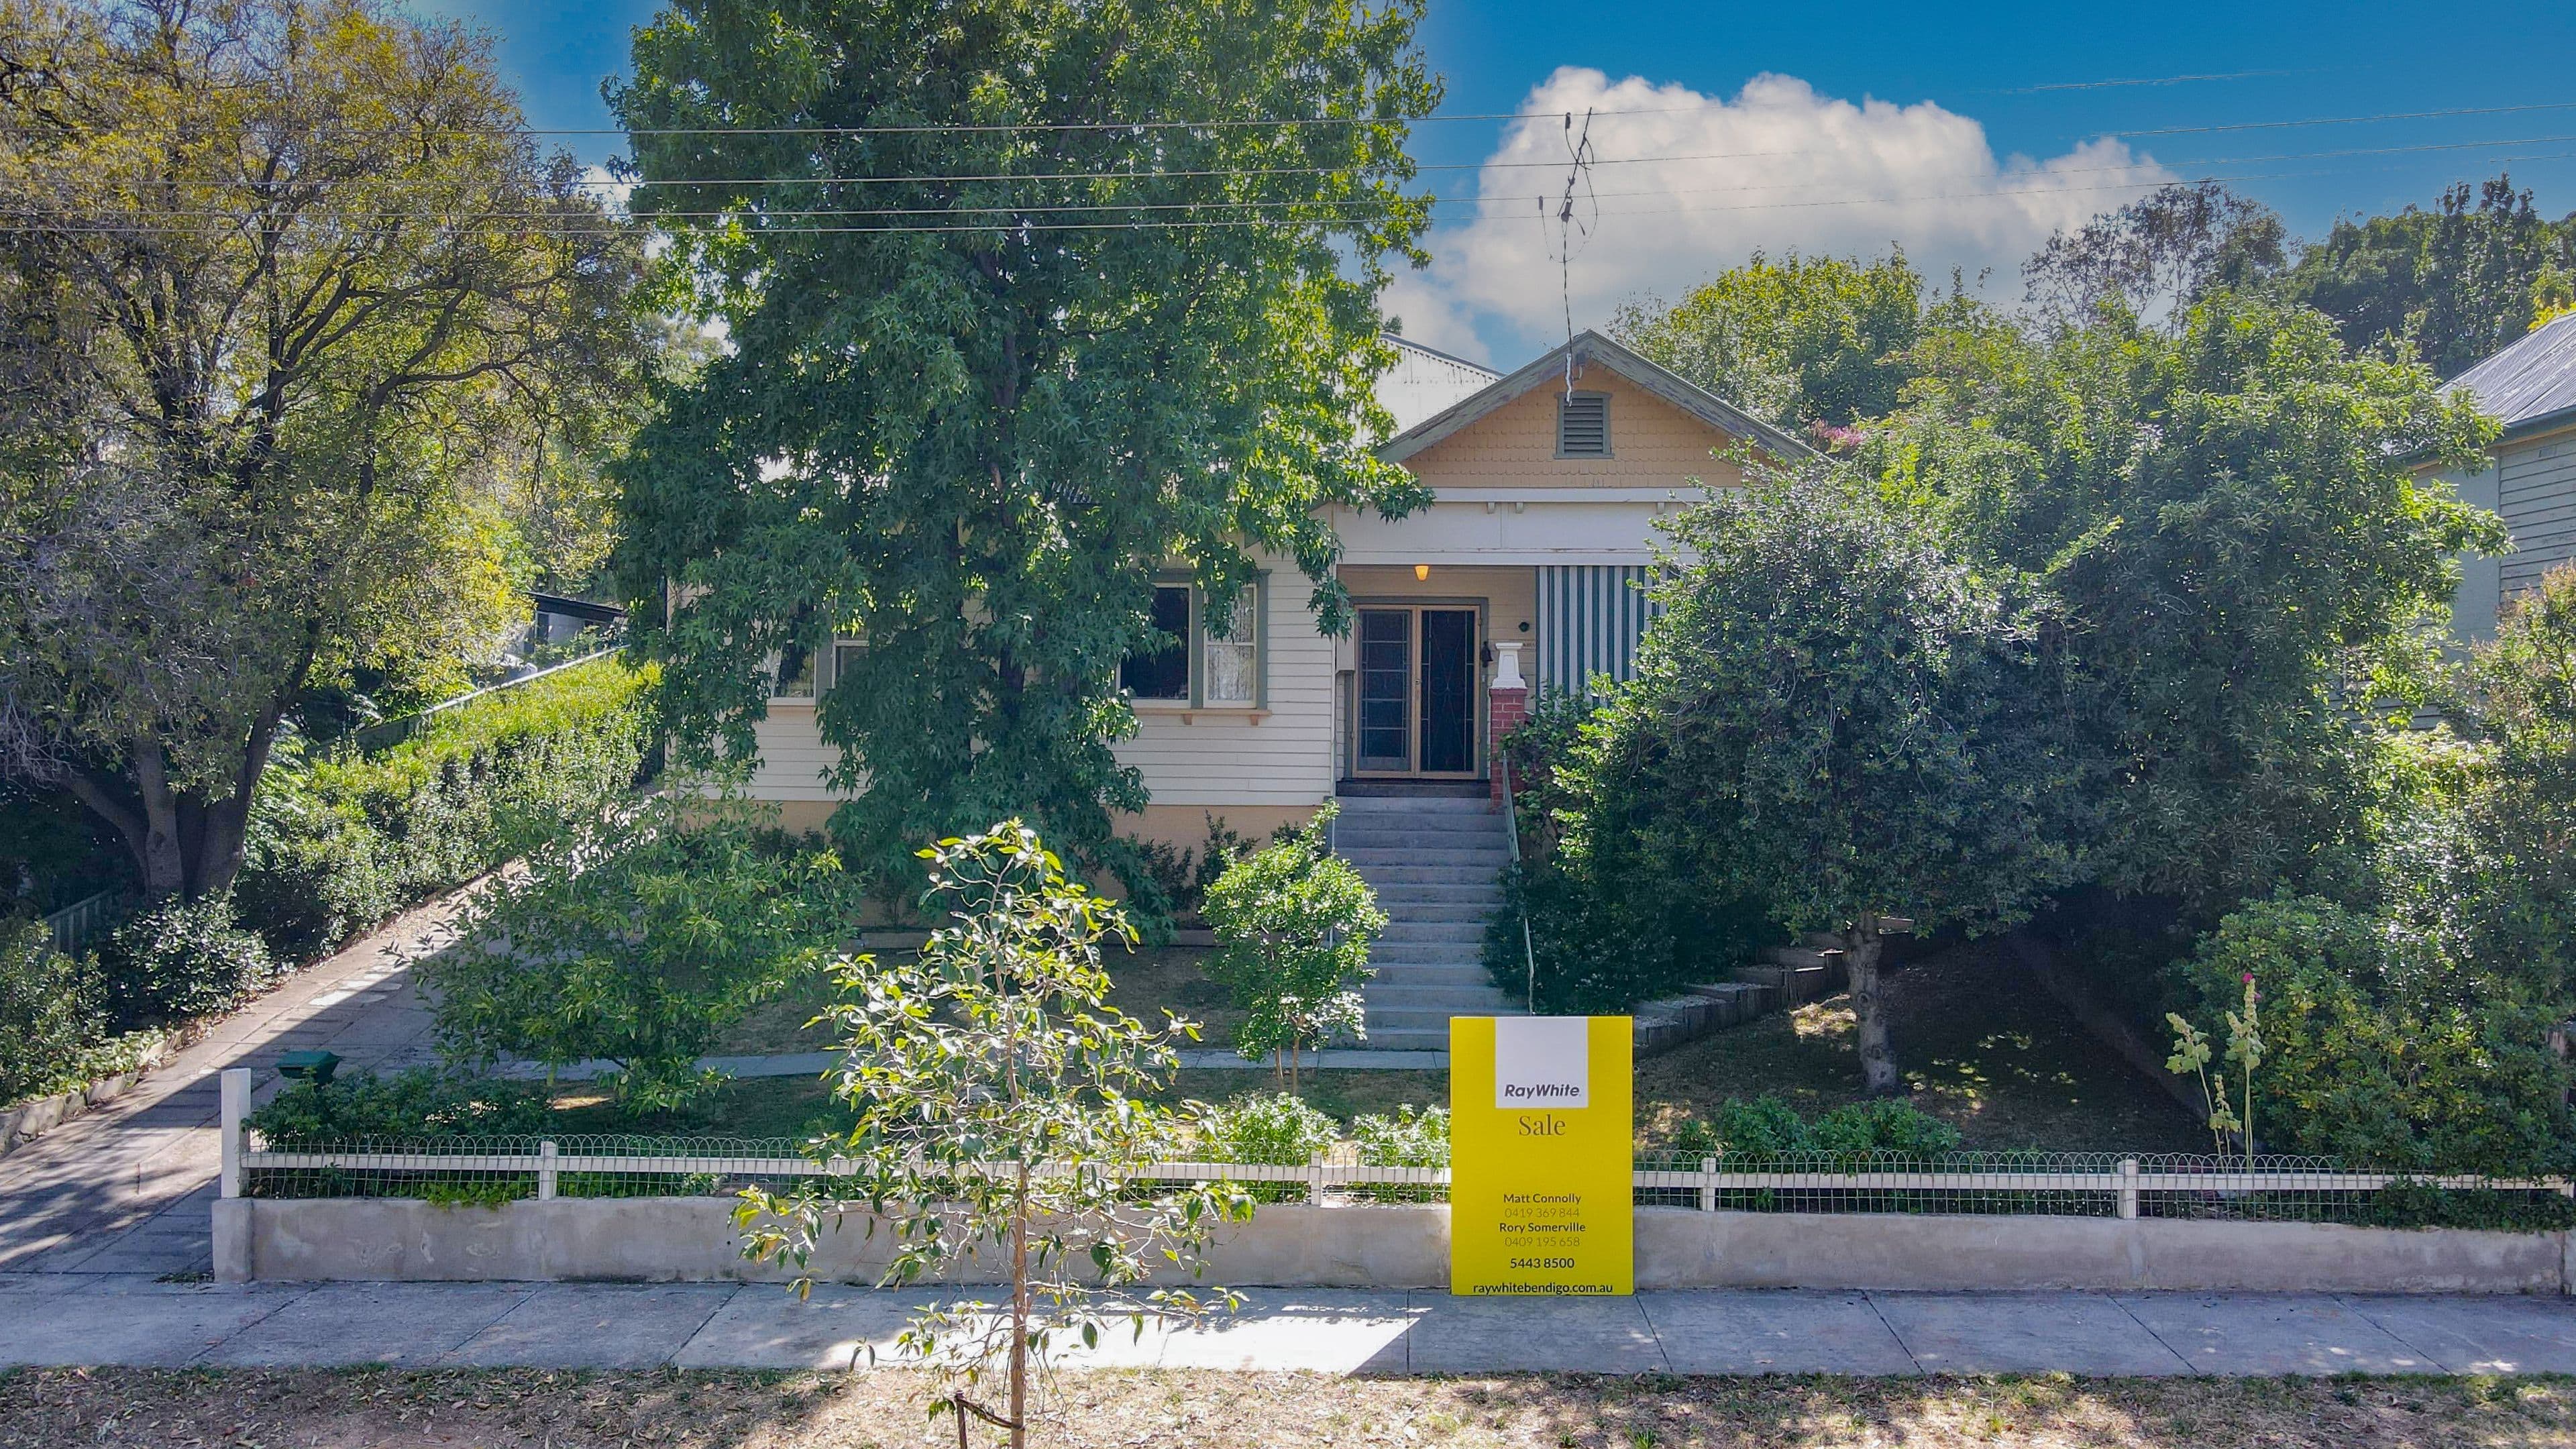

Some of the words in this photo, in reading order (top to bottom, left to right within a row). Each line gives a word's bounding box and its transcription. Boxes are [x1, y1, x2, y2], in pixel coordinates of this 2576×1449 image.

[1504, 1084, 1580, 1099] RayWhite
[1519, 1114, 1565, 1136] Sale
[1503, 1194, 1529, 1203] Matt
[1533, 1193, 1581, 1205] Connolly
[1505, 1208, 1533, 1218] 0419
[1536, 1208, 1556, 1218] 369
[1559, 1208, 1579, 1218] 844
[1499, 1223, 1525, 1234] Rory
[1527, 1222, 1586, 1232] Somerville
[1505, 1237, 1533, 1247] 0409
[1536, 1237, 1556, 1247] 195
[1559, 1237, 1580, 1247] 658
[1510, 1258, 1540, 1269] 5443
[1544, 1258, 1574, 1269] 8500
[1473, 1282, 1613, 1295] raywhitebendigo.com.au
